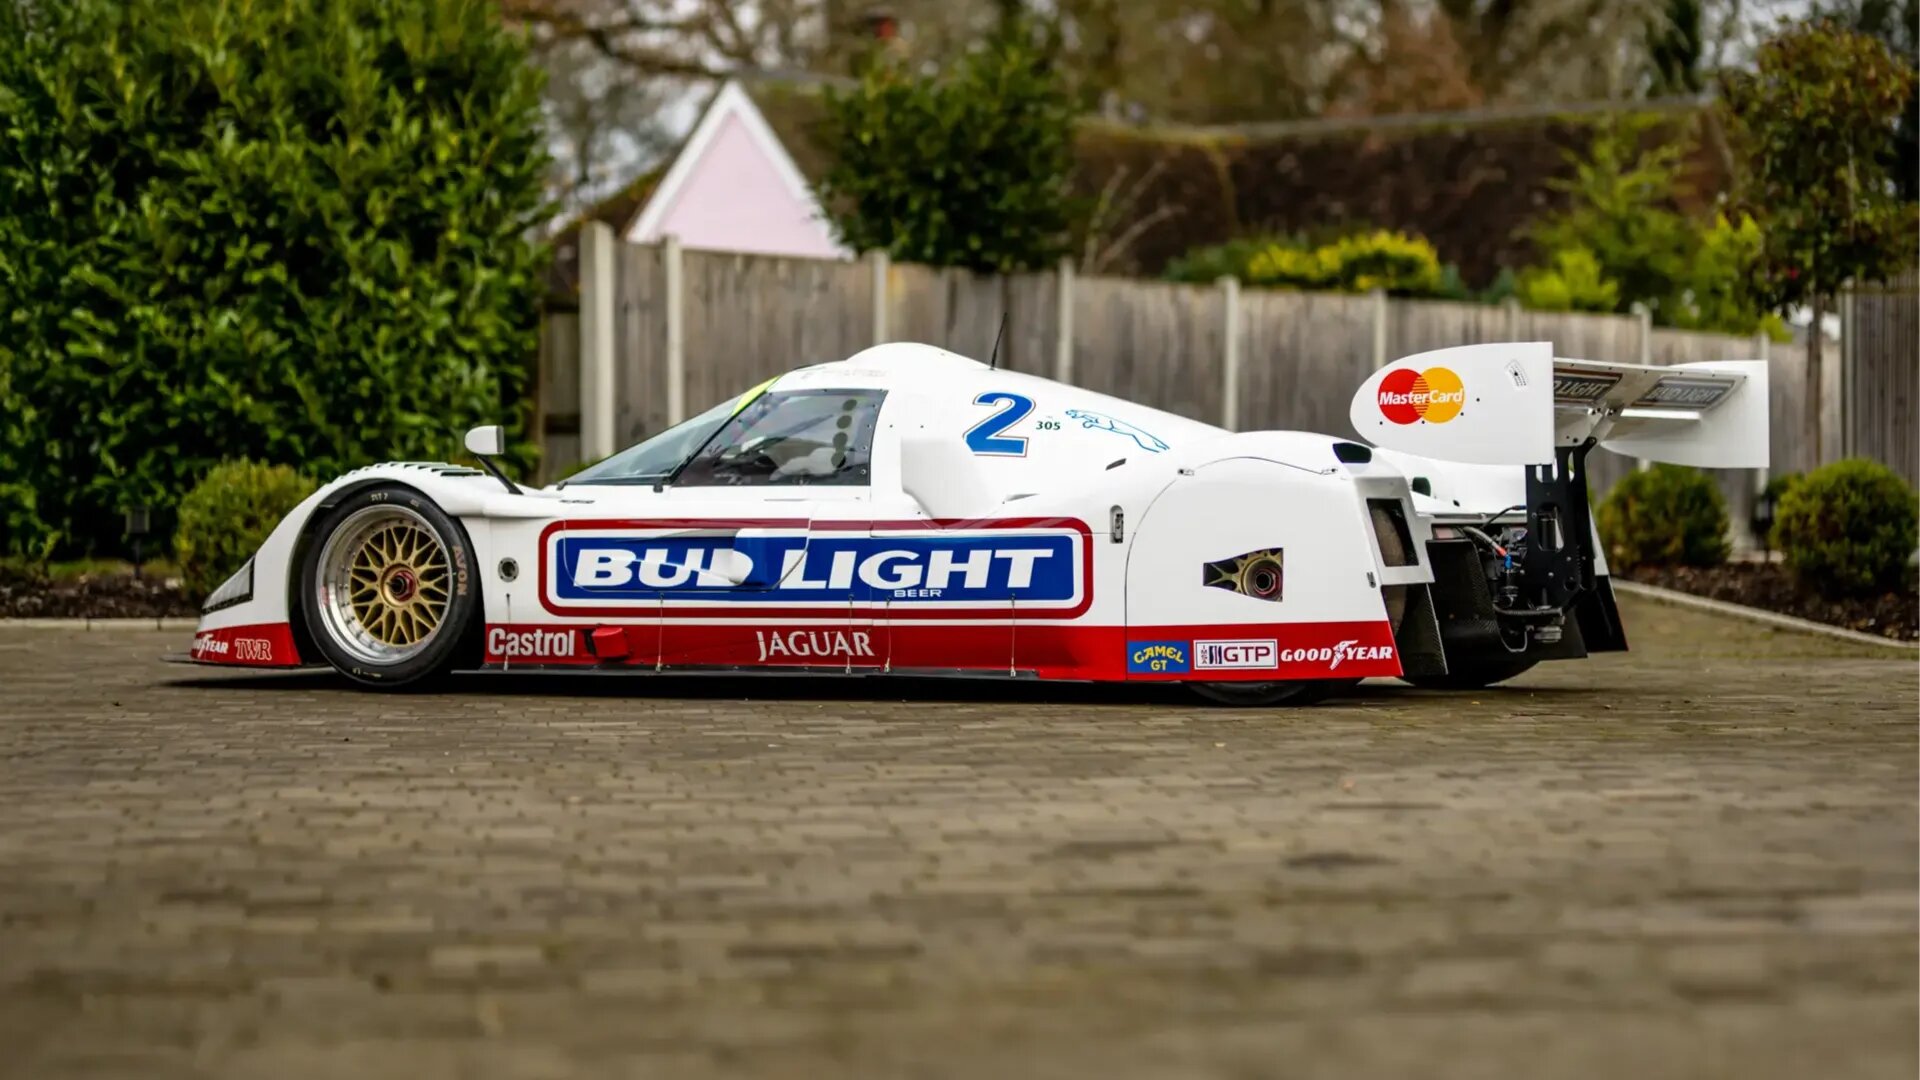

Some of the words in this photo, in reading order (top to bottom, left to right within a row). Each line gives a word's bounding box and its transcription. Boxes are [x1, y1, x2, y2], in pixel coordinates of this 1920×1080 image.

[1379, 388, 1463, 405] MasterCard
[1561, 381, 1610, 397] LIGHT
[963, 391, 1035, 457] 2
[1035, 420, 1061, 431] 305
[453, 545, 468, 596] AVON
[573, 548, 754, 588] BUD
[779, 549, 1053, 590] LIGHT
[894, 589, 942, 598] BEER
[234, 638, 272, 660] TWR
[488, 628, 575, 657] Castrol
[756, 631, 875, 662] JAGUAR
[1133, 645, 1184, 663] CAMEL
[1223, 646, 1271, 662] GTP
[1150, 660, 1168, 671] GT
